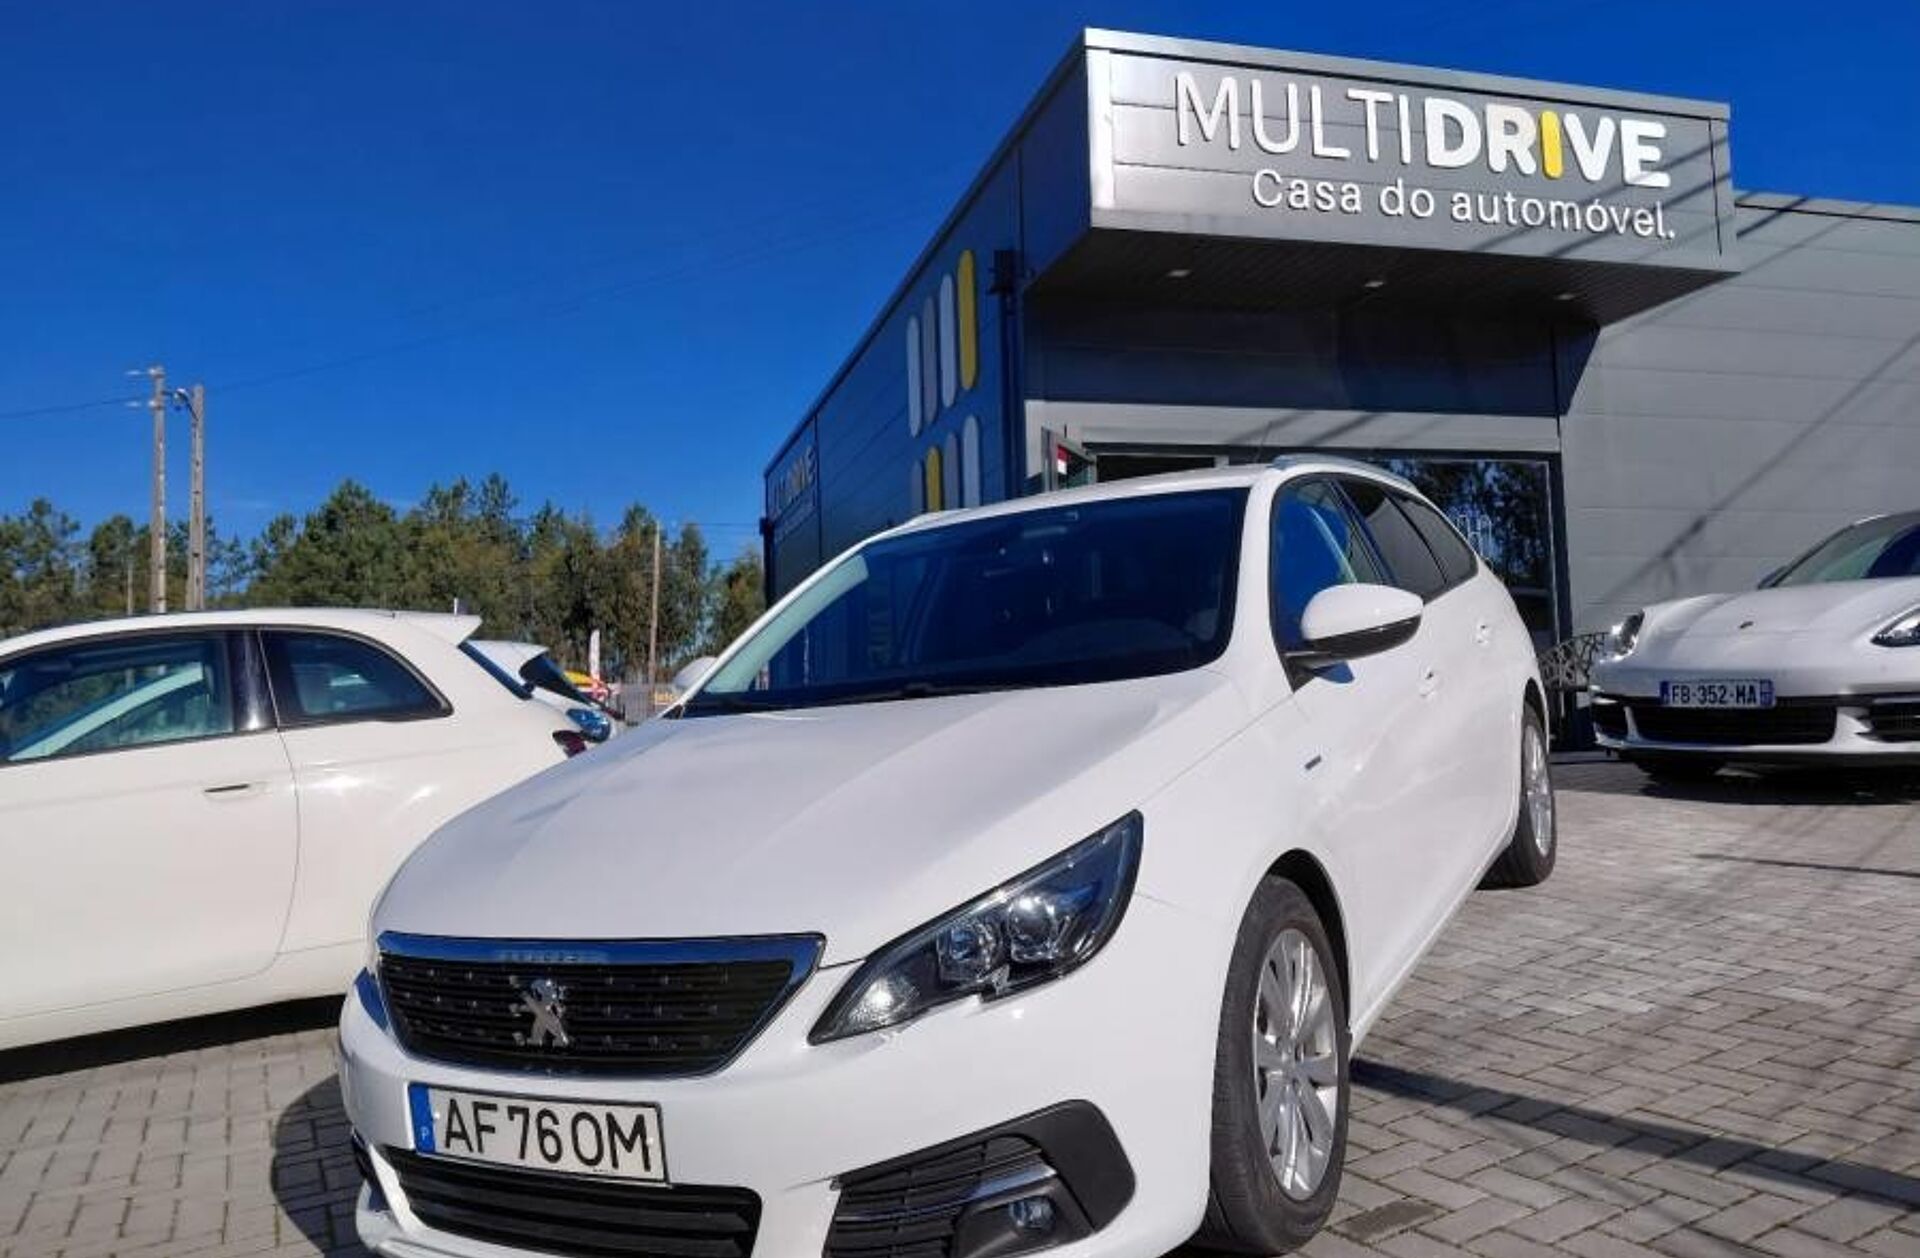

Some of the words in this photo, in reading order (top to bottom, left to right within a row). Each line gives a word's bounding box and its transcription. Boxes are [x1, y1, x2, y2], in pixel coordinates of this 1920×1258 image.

[1253, 168, 1363, 214] Casa
[1379, 176, 1435, 218] do
[1450, 190, 1676, 239] automóvel.
